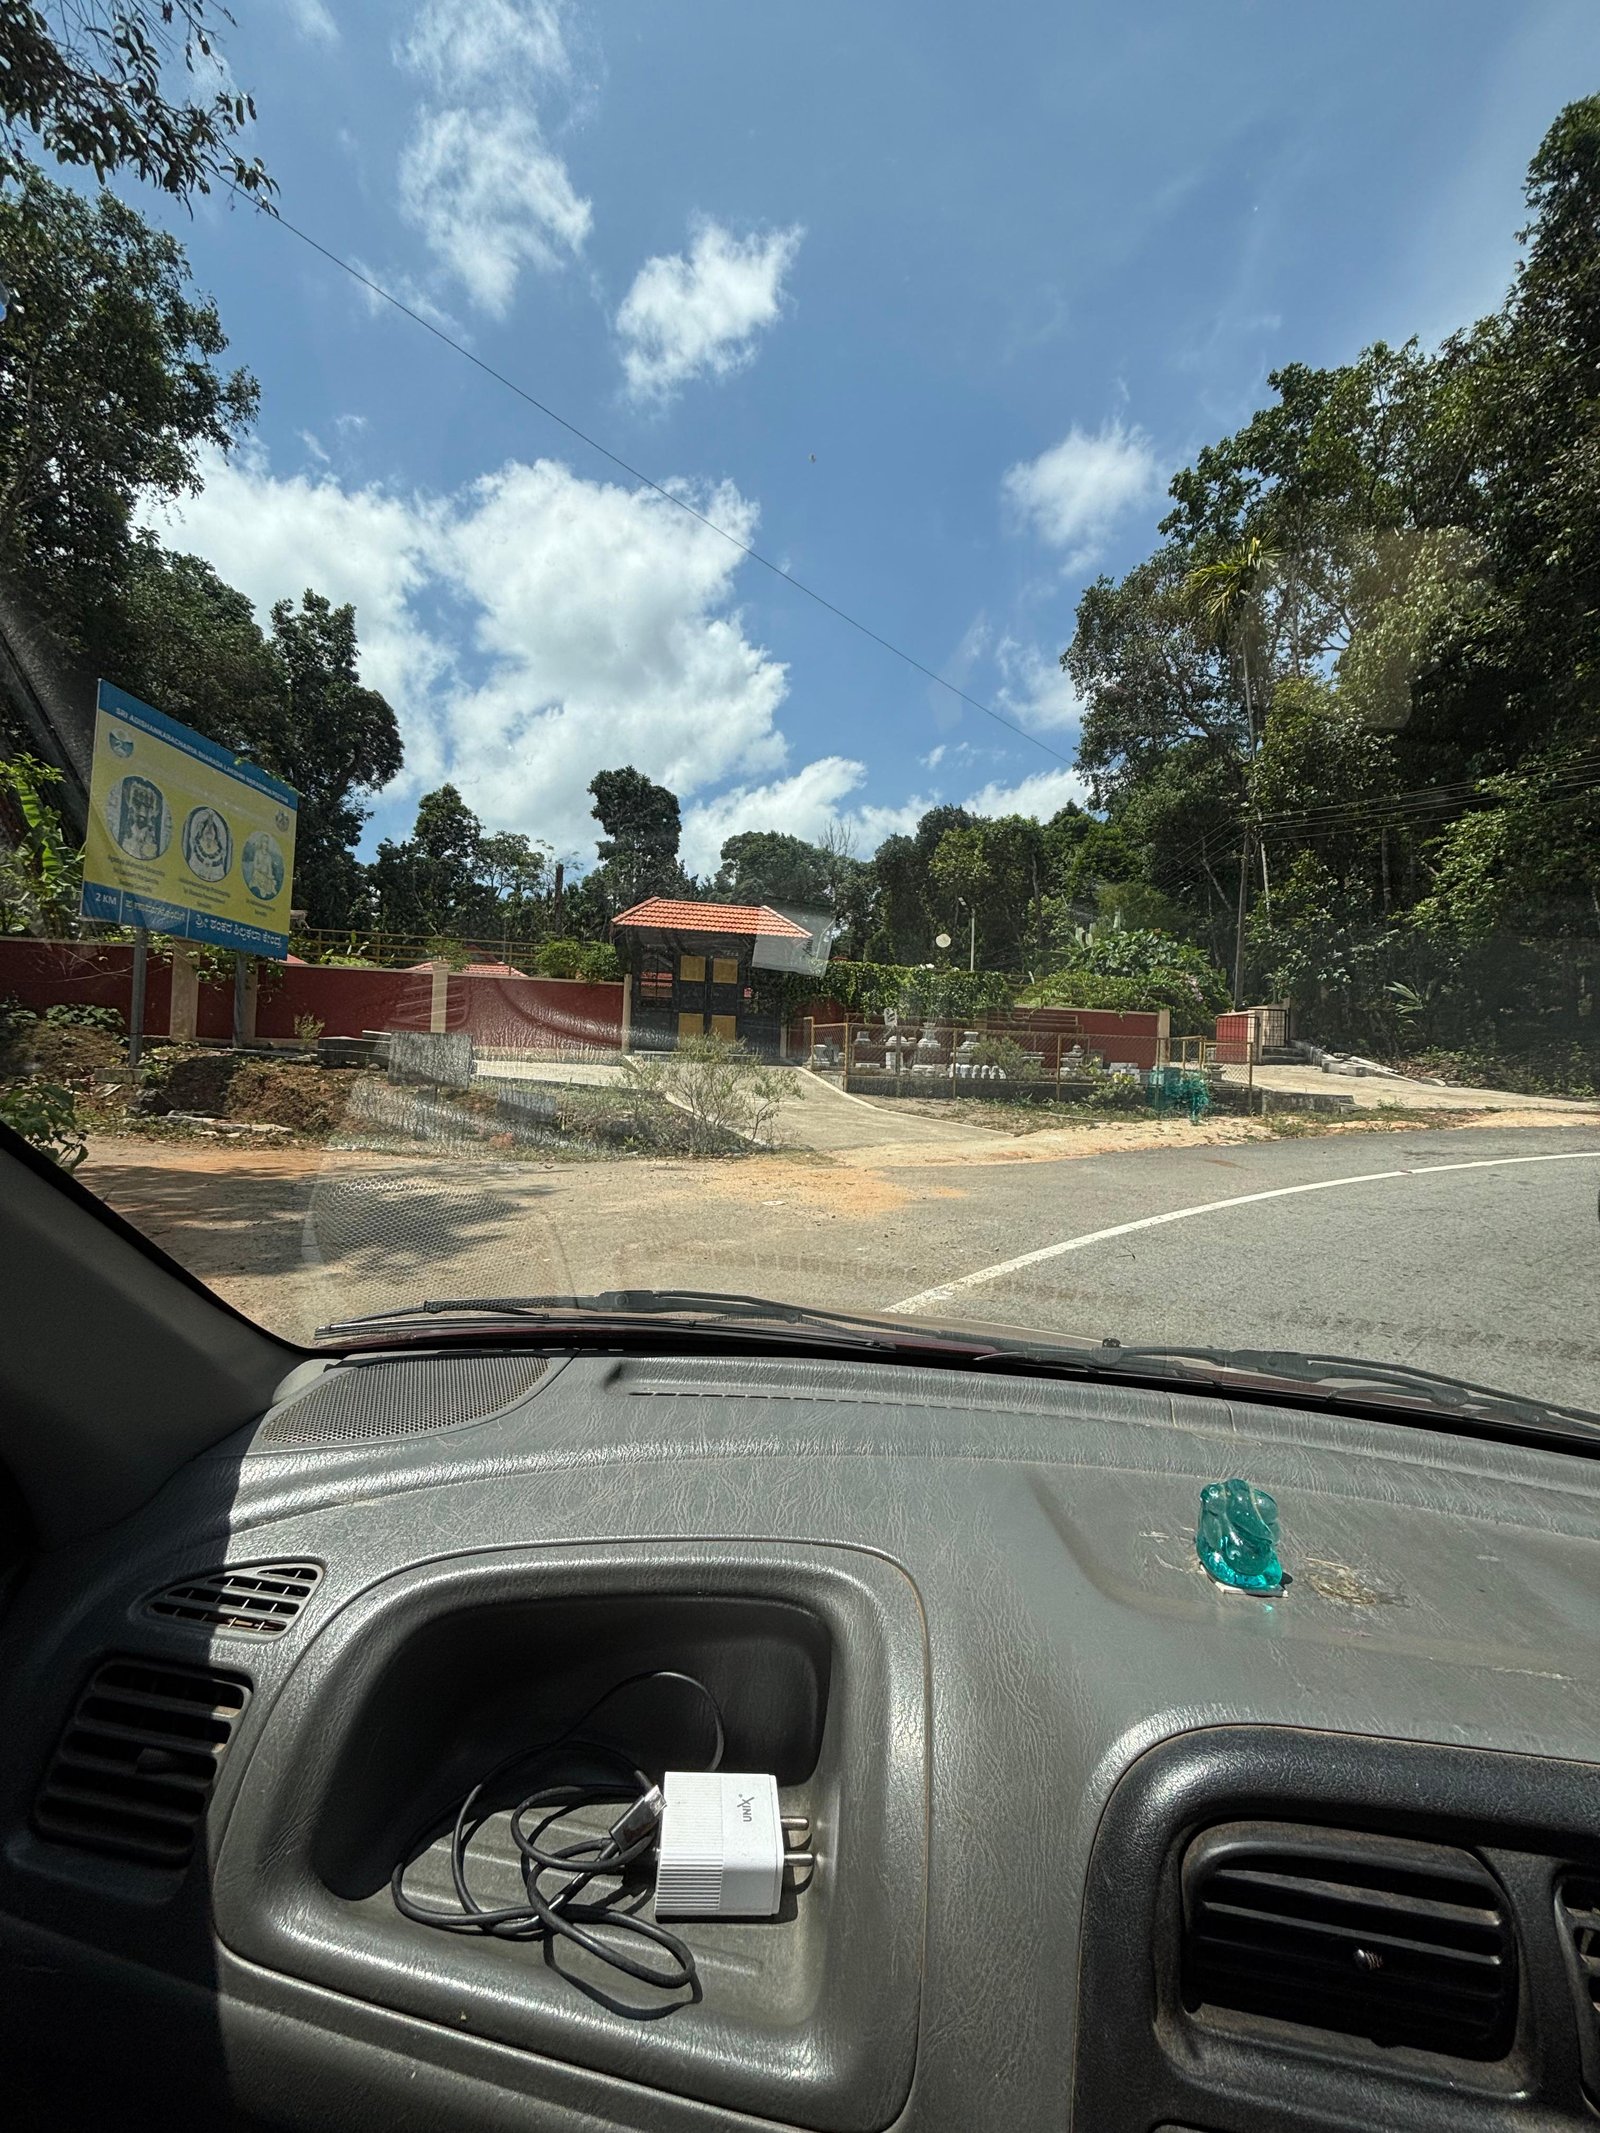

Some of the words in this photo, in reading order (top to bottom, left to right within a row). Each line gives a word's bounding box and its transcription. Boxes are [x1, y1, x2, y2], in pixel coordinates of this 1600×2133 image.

[95, 892, 102, 903] 2
[102, 894, 117, 906] KM
[736, 1795, 755, 1823] UNIX
